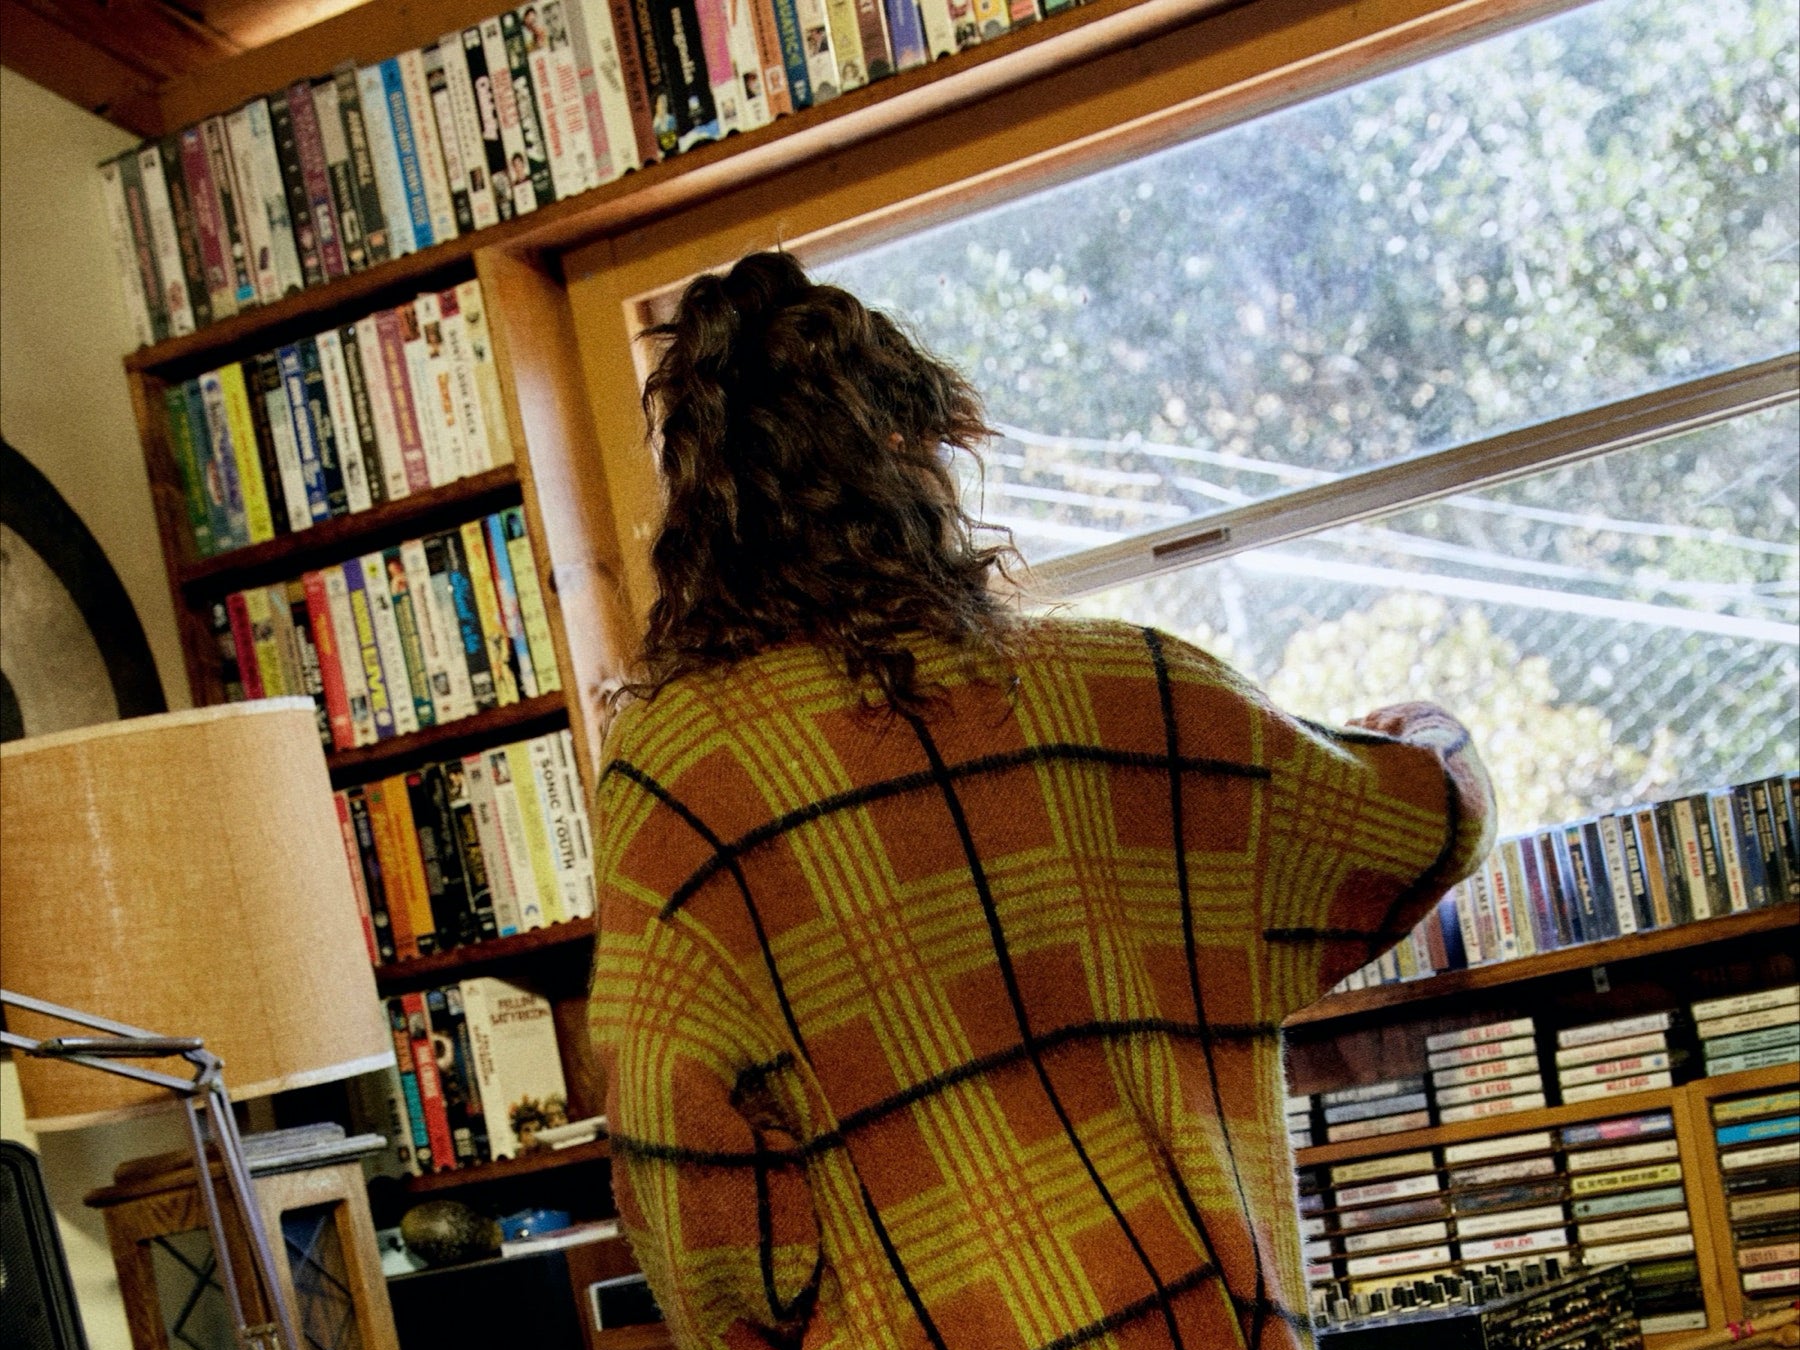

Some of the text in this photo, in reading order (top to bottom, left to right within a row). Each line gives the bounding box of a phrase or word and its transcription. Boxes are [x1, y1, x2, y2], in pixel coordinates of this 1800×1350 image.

[668, 6, 696, 85] magnolia
[390, 91, 411, 153] BROADWAY
[540, 757, 561, 810] SONIC
[552, 815, 575, 870] YOUTH
[1618, 1057, 1642, 1071] DAVIS
